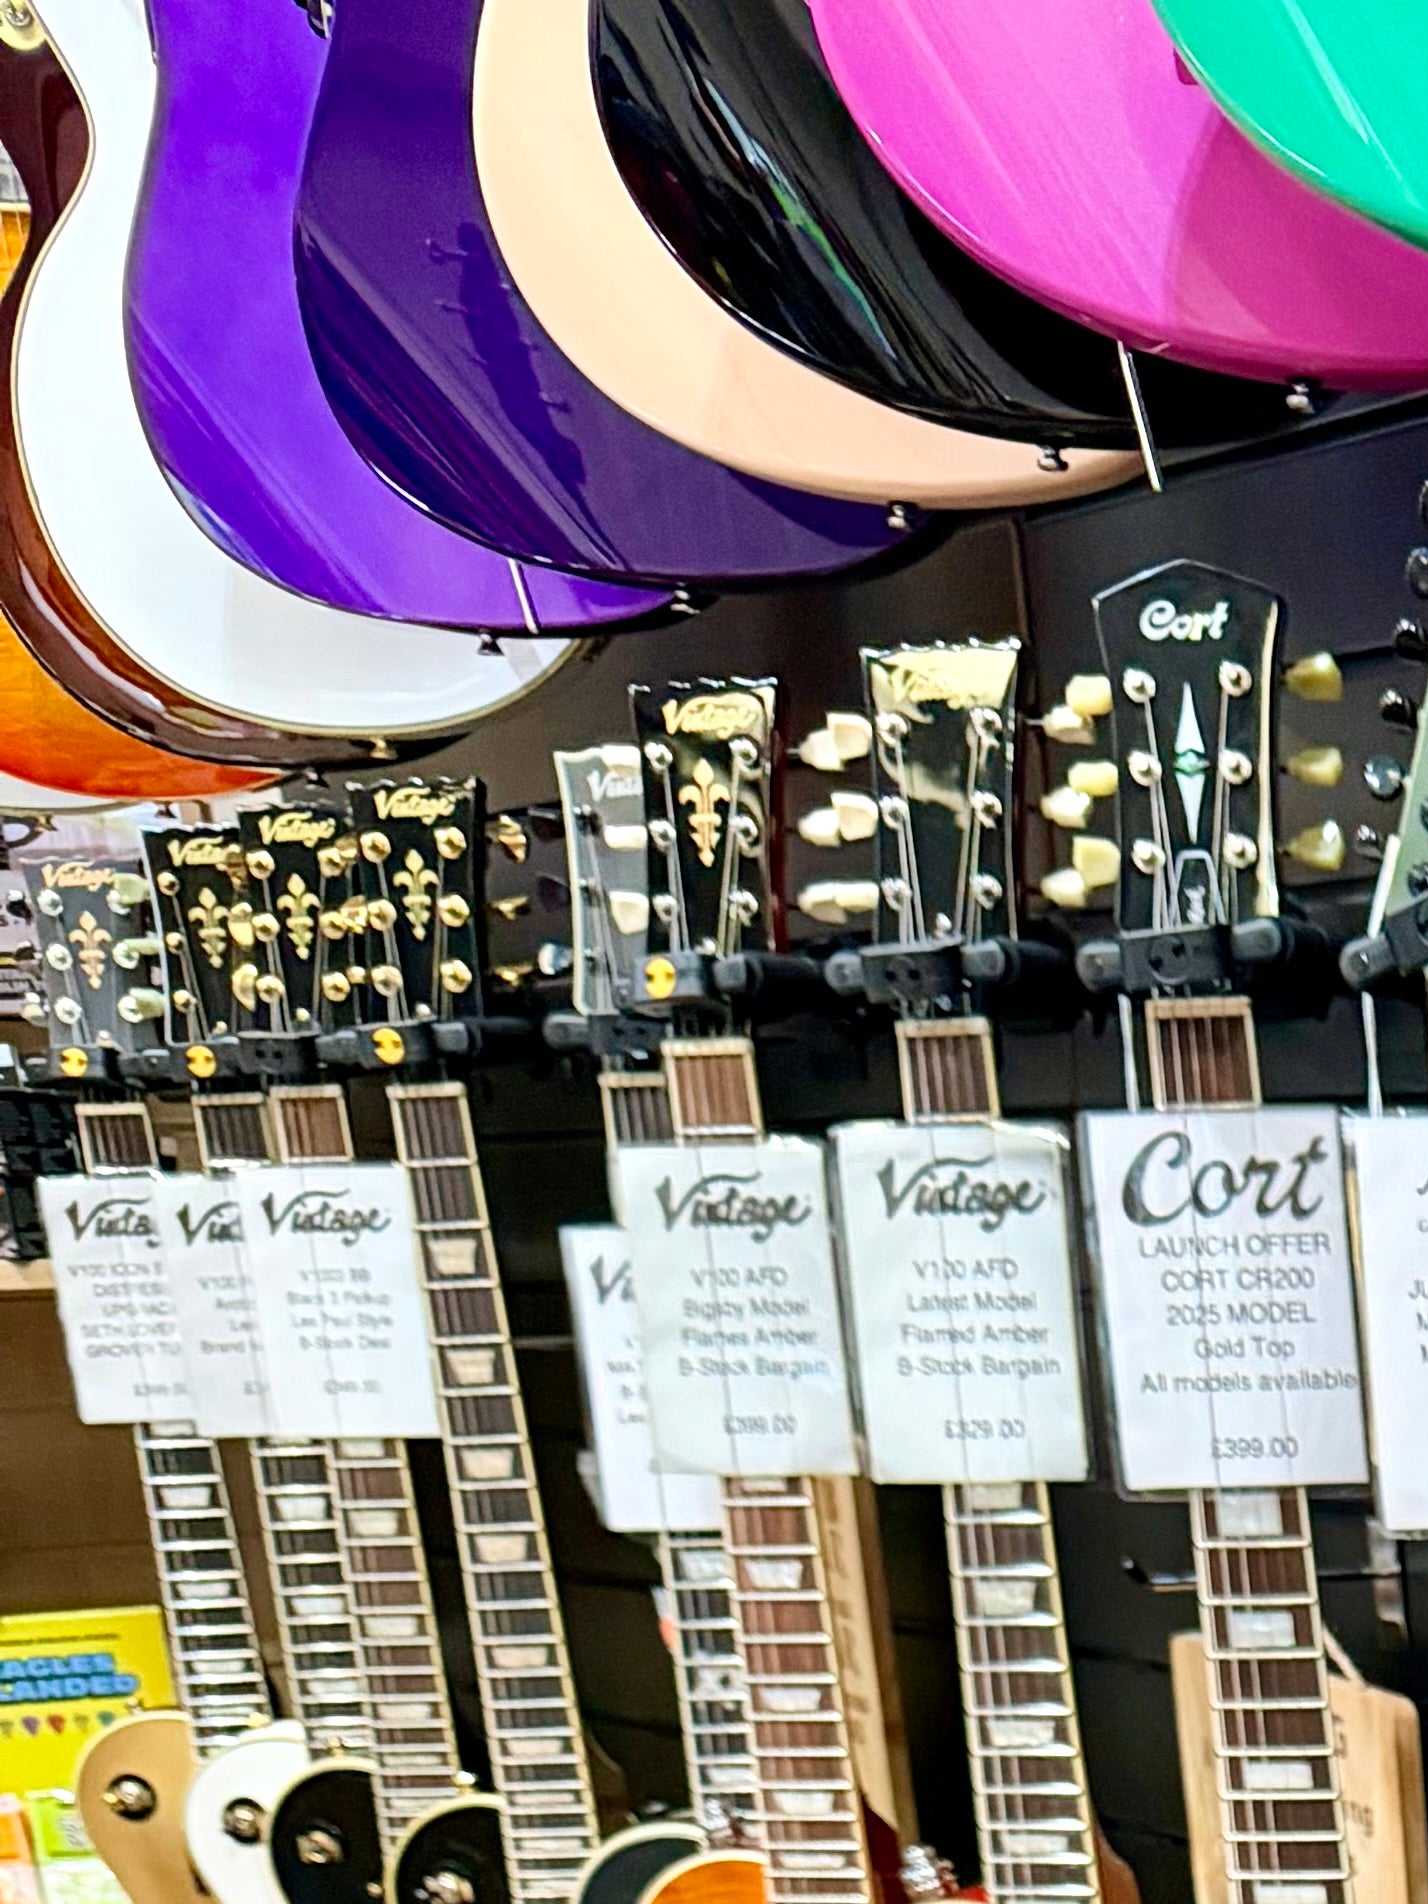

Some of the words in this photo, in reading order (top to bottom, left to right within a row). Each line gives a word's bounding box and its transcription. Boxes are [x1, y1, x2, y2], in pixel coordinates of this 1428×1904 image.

[1140, 600, 1229, 640] Cort
[1122, 1130, 1328, 1227] Cort
[655, 1170, 813, 1243] Vintage
[877, 1155, 1046, 1233] Vintage
[261, 1187, 392, 1247] Vintage
[1139, 1234, 1241, 1259] LAUNCH
[1245, 1232, 1331, 1257] OFFER
[1160, 1268, 1229, 1293] CORT
[1236, 1266, 1315, 1290] CR200
[974, 1290, 1038, 1312] Model
[1166, 1304, 1222, 1327] 2025
[1228, 1301, 1316, 1325] MODEL
[983, 1323, 1049, 1345] Amber
[1194, 1338, 1246, 1360] Gold
[1252, 1336, 1296, 1361] Top
[982, 1356, 1061, 1381] Bargain
[1140, 1372, 1168, 1394] All
[1174, 1371, 1252, 1393] models
[1259, 1368, 1359, 1392] available
[0, 1653, 114, 1680] ACLES
